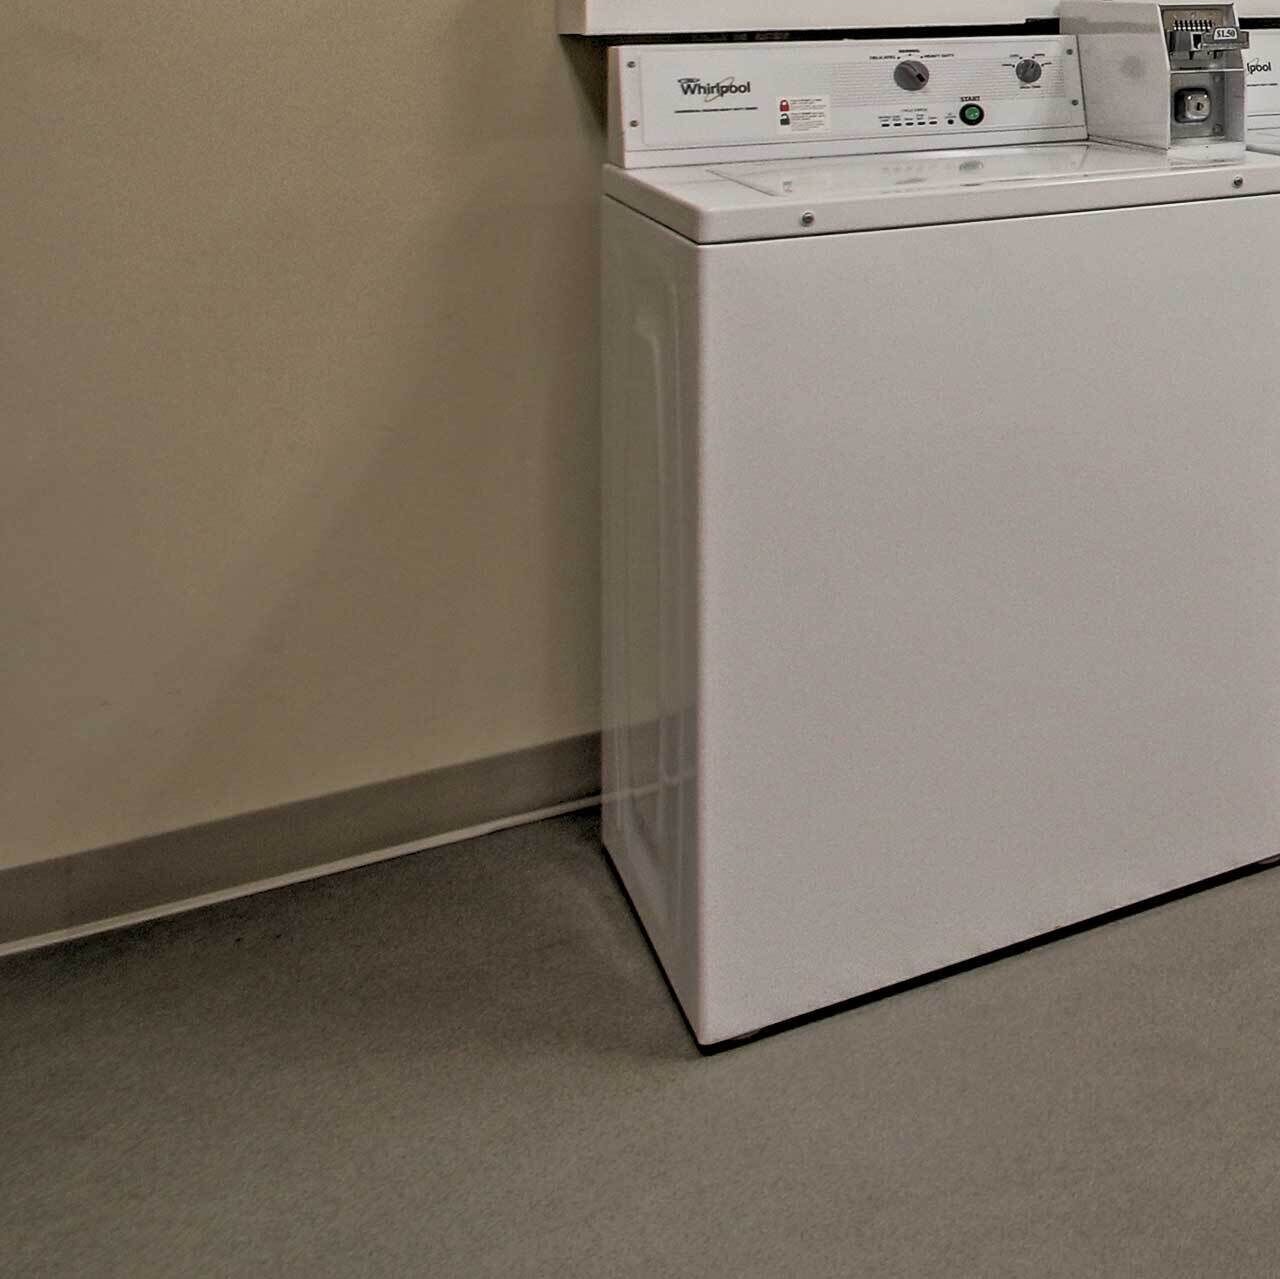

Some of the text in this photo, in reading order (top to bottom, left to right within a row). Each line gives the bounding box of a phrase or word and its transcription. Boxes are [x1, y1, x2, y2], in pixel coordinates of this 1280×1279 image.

[1216, 29, 1236, 38] $1.50
[1246, 61, 1272, 75] lpool
[680, 80, 751, 98] Whirlpool
